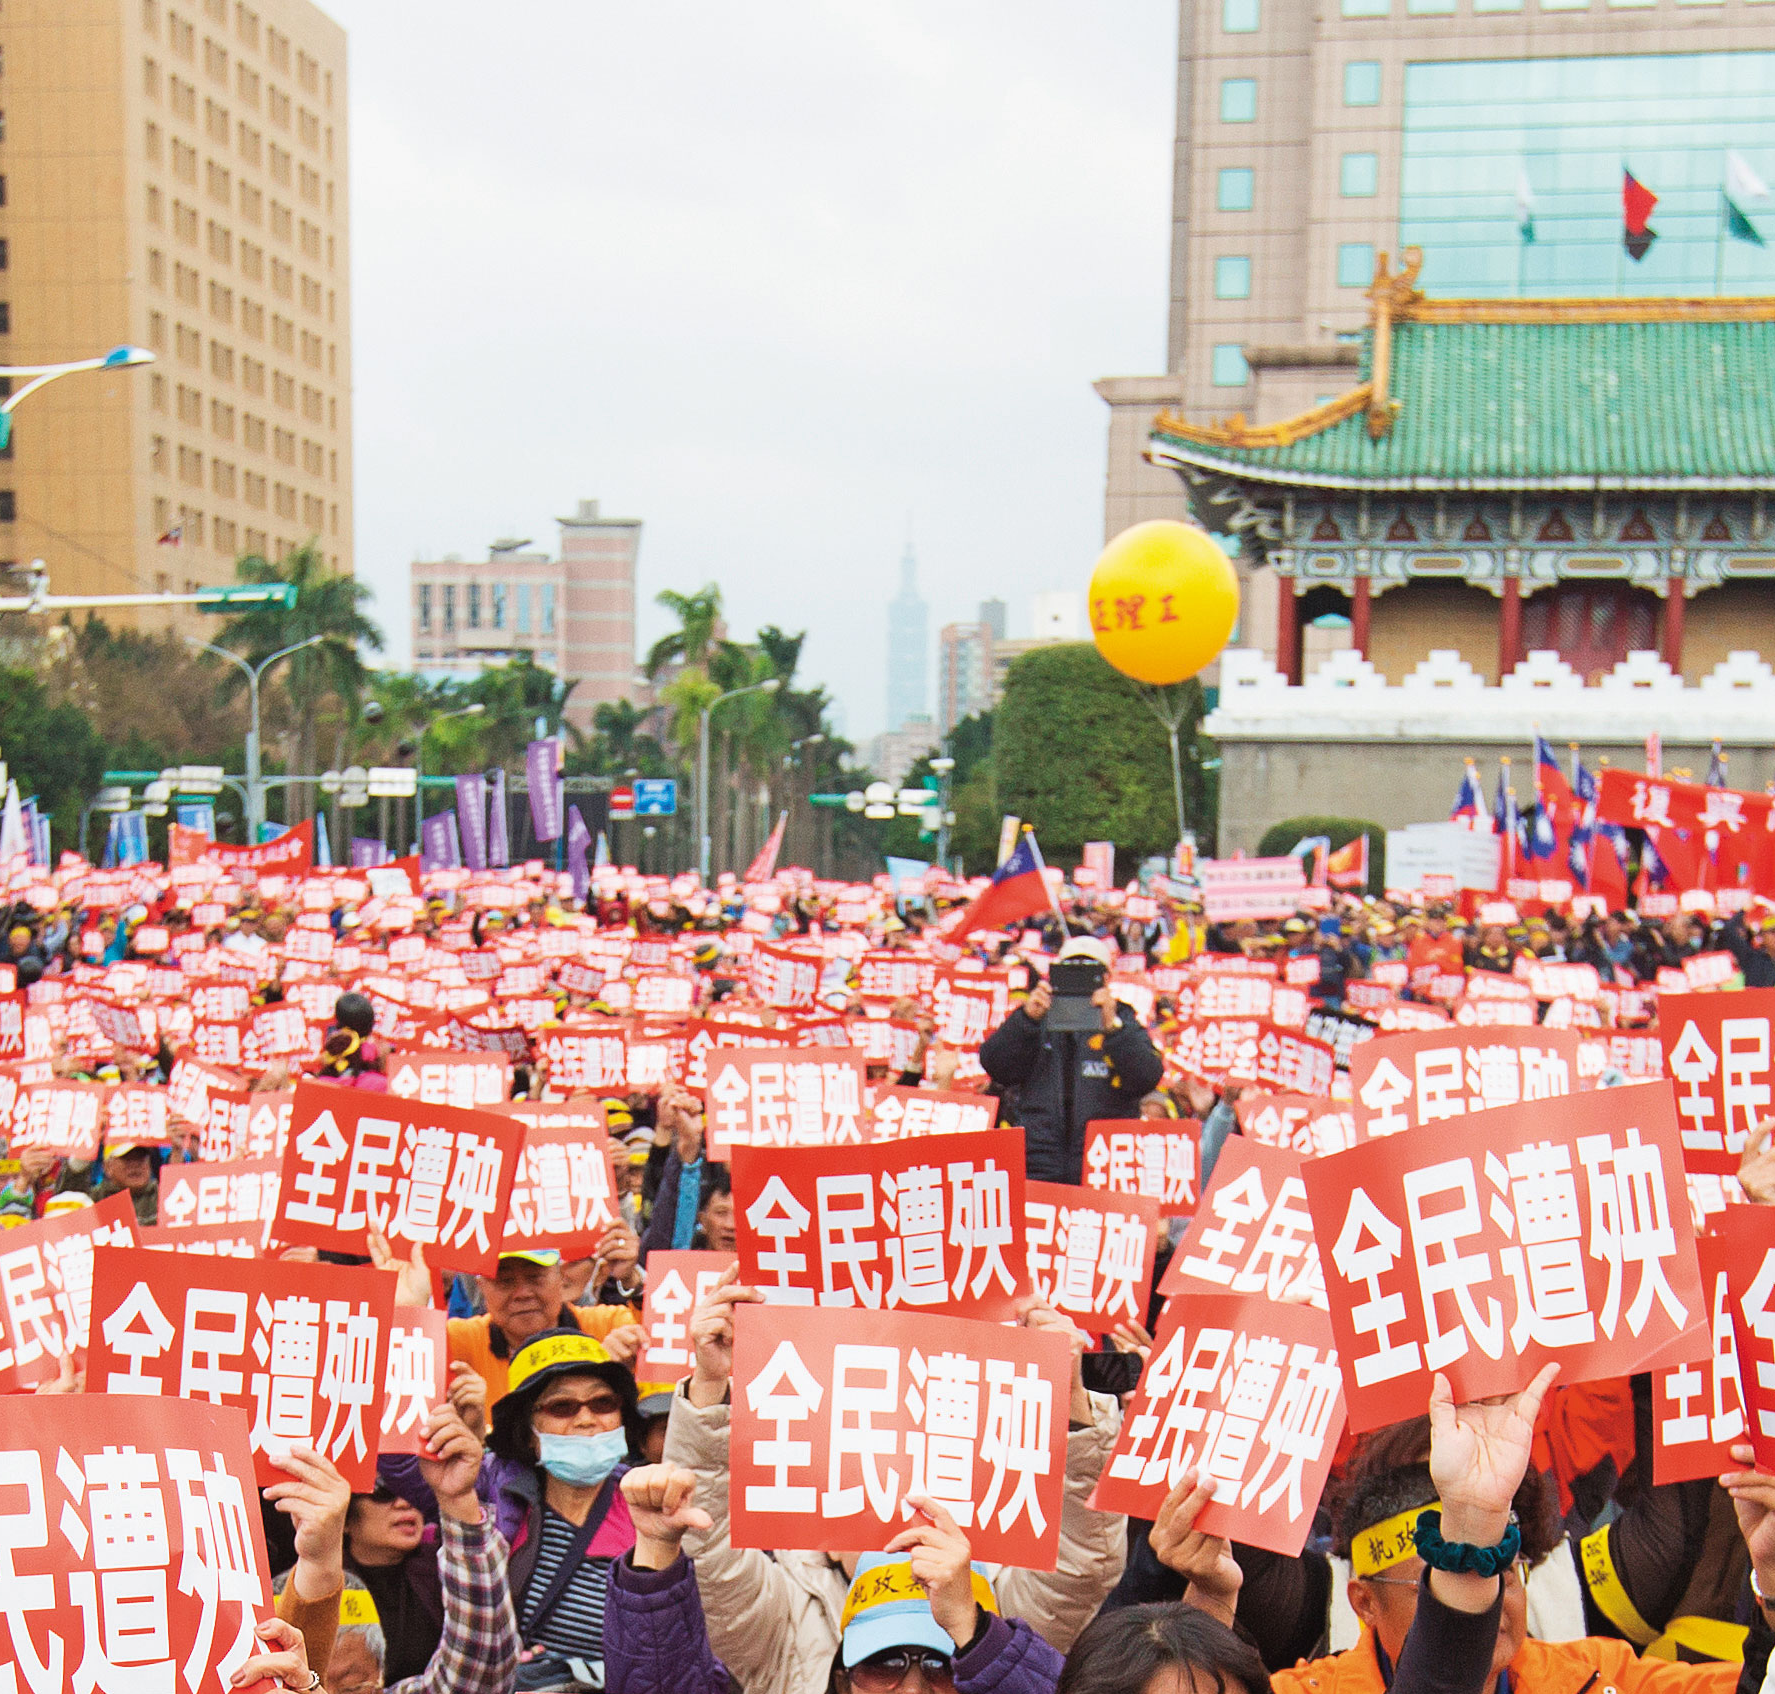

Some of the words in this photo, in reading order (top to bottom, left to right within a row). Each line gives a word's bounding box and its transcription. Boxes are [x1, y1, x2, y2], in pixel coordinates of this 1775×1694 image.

[11, 1088, 99, 1155] 全民遭殃
[548, 1036, 624, 1088] 全民遭殃
[712, 1063, 860, 1146] 全民遭殃
[285, 1111, 503, 1254] 全民遭殃
[745, 1159, 1017, 1309] 全民遭殃
[1087, 1132, 1196, 1205] 全民遭殃
[1332, 1128, 1689, 1390] 全民遭殃
[100, 1282, 378, 1463] 全民遭殃
[746, 1341, 1051, 1540] 全民遭殃
[1108, 1327, 1342, 1523] 全民遭殃
